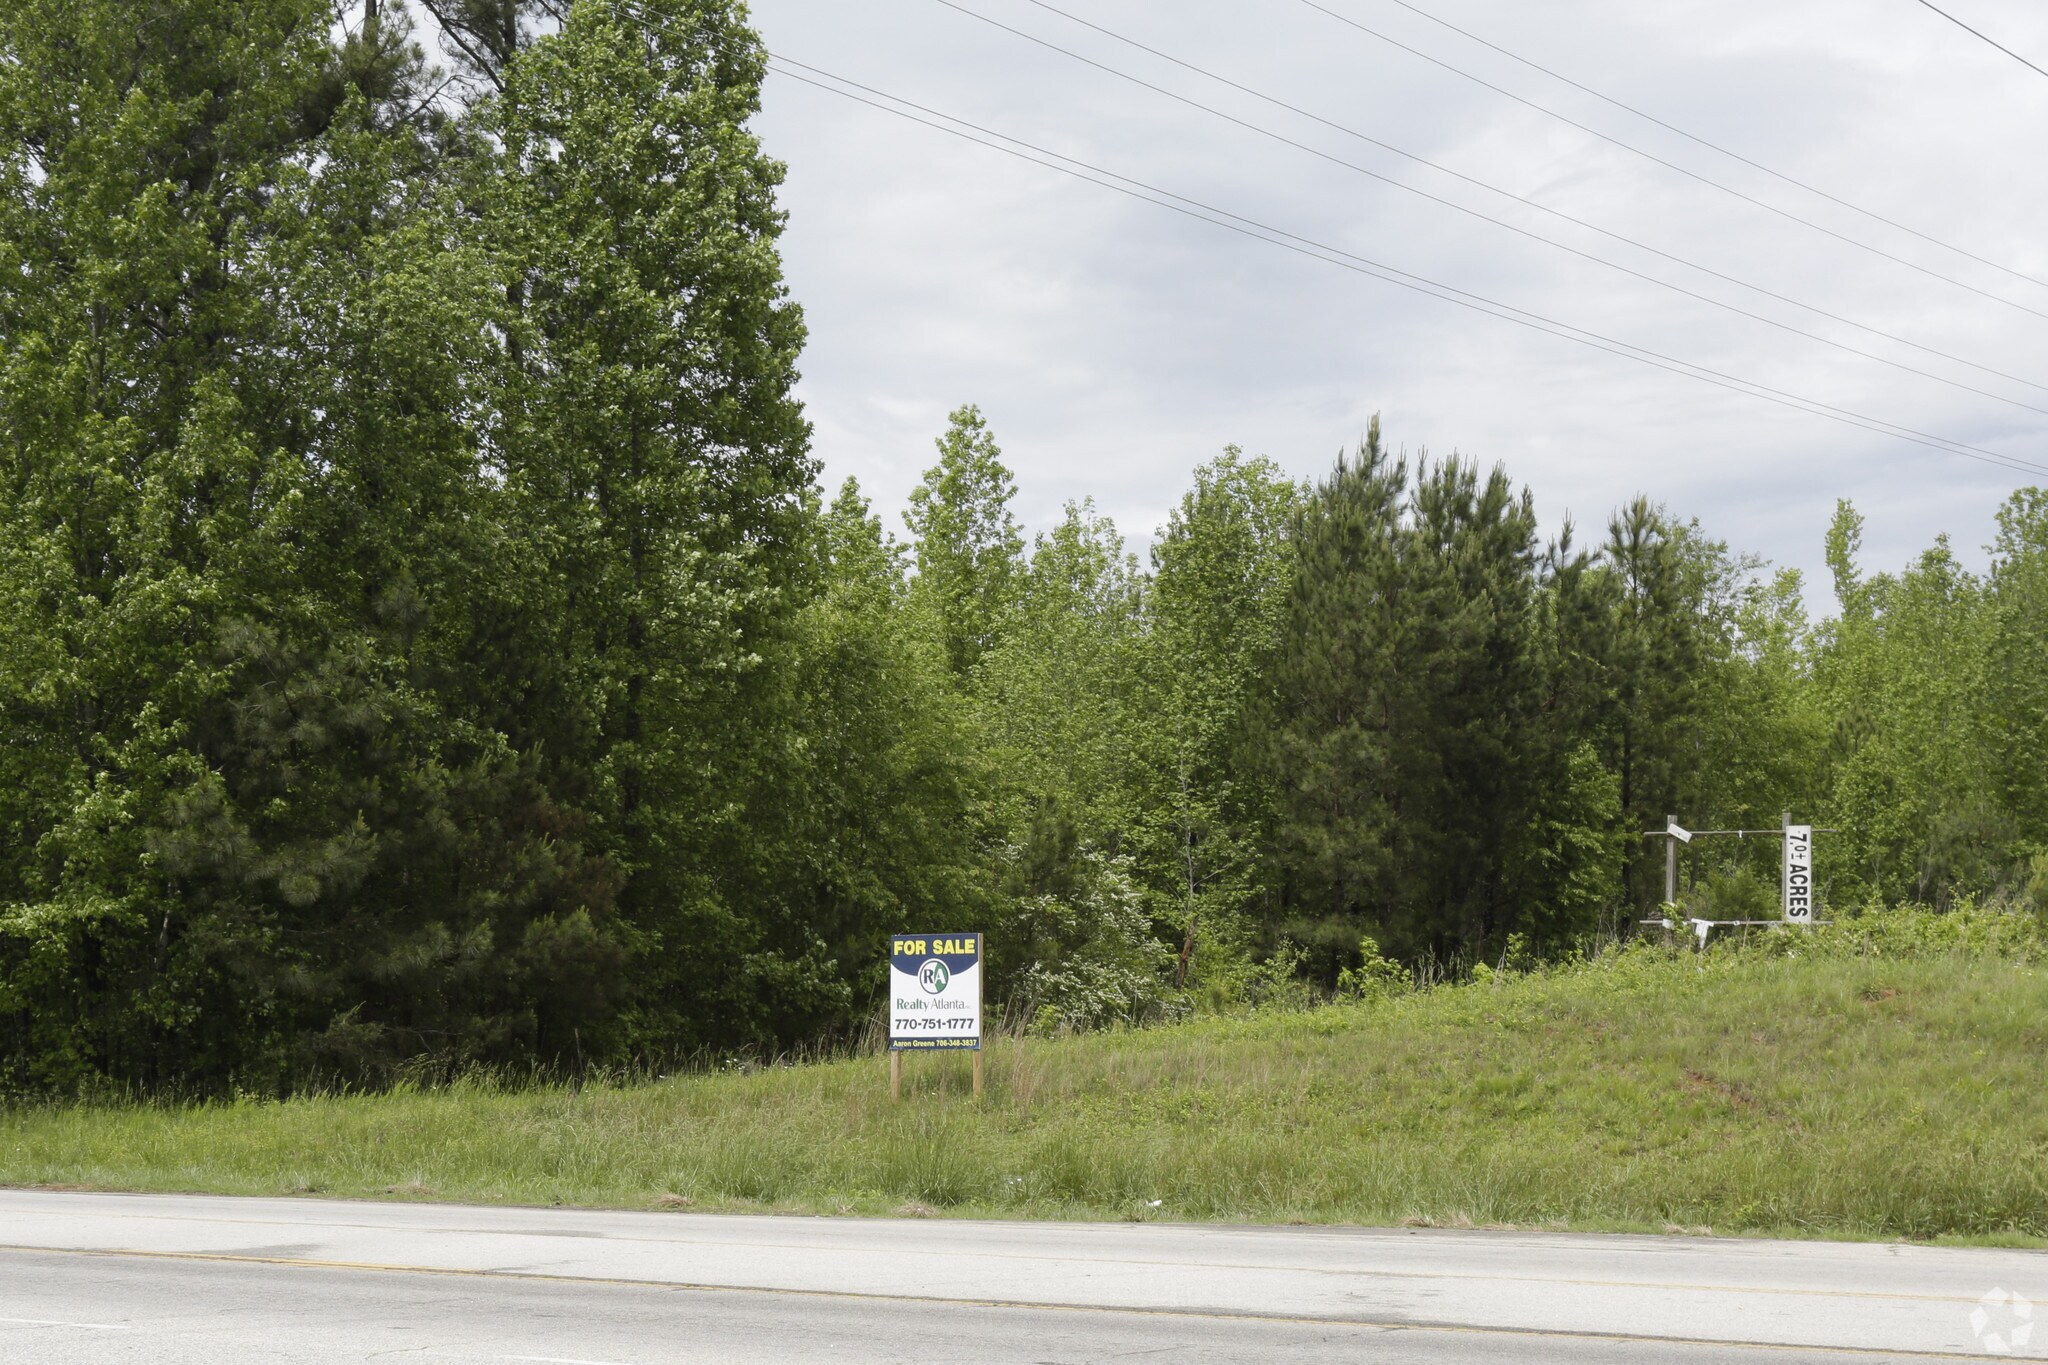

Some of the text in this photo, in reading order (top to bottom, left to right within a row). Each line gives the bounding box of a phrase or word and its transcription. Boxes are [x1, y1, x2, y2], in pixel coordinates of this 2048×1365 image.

[1789, 864, 1808, 917] ACRES
[893, 939, 975, 956] FOR SALE
[923, 969, 946, 984] RA
[896, 998, 965, 1012] Realty Atlanta
[895, 1018, 974, 1030] 770-751-1777
